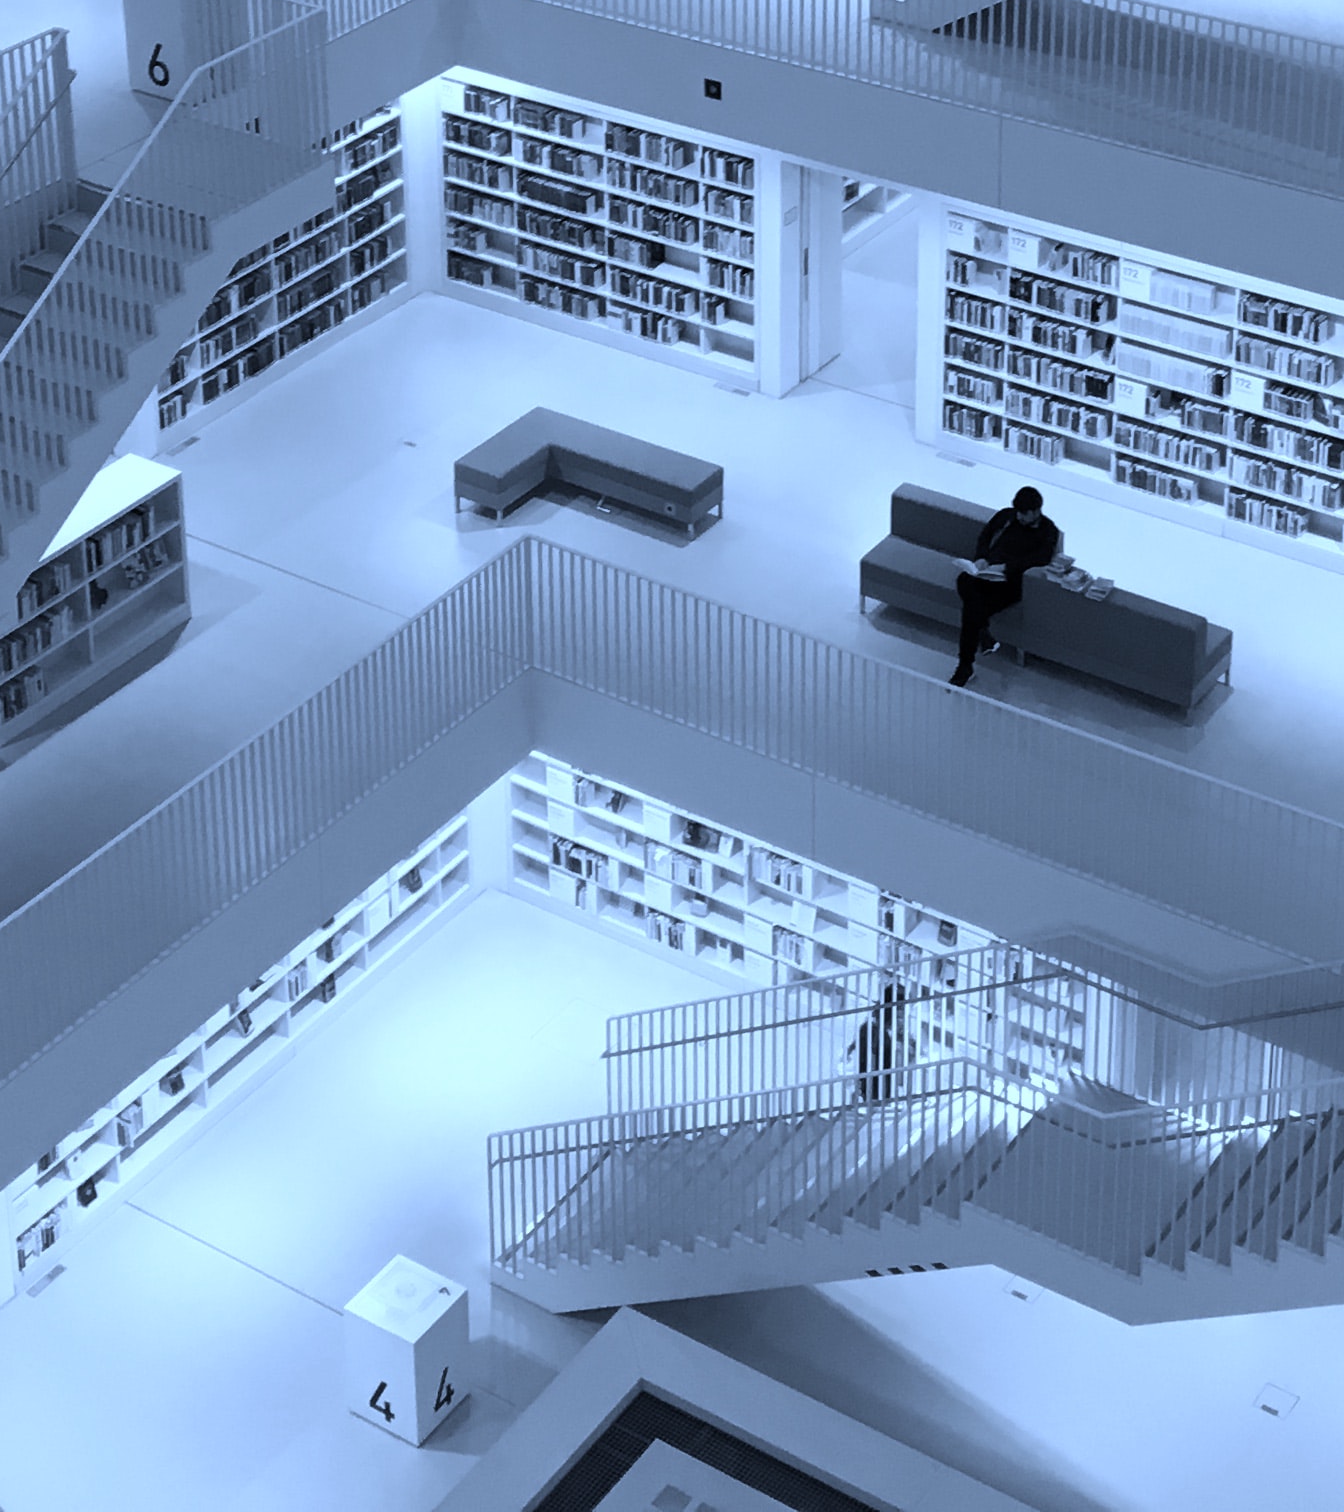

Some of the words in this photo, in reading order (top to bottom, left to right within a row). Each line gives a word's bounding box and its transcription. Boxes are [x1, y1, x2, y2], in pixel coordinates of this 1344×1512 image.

[148, 43, 170, 87] 6
[1011, 236, 1027, 248] 172
[1123, 267, 1139, 279] 172
[369, 1380, 395, 1422] 4
[433, 1366, 455, 1412] 4
